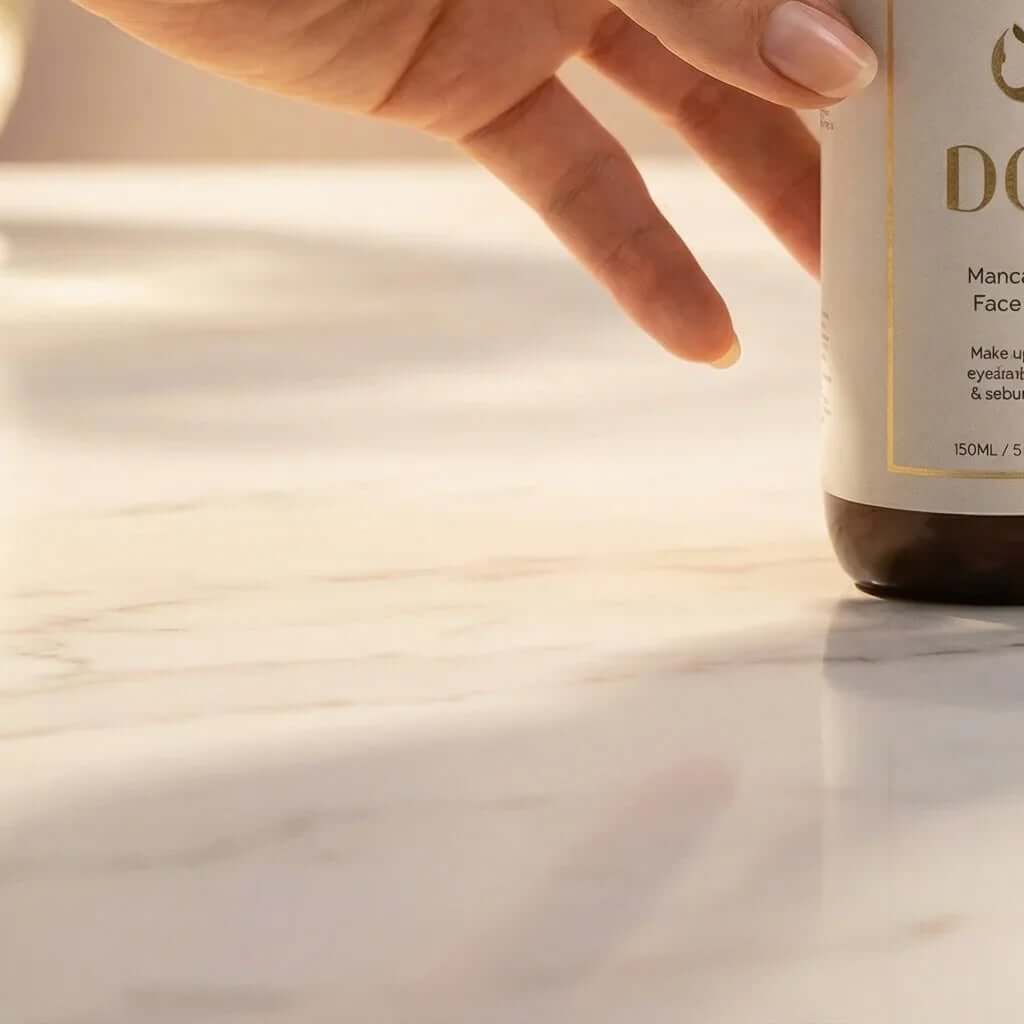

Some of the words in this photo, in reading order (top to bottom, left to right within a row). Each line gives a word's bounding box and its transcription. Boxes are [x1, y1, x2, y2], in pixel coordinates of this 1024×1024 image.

[973, 295, 1021, 311] Face
[971, 346, 1008, 360] Make
[969, 387, 982, 400] &
[955, 443, 997, 456] 150ML
[1001, 443, 1010, 456] /
